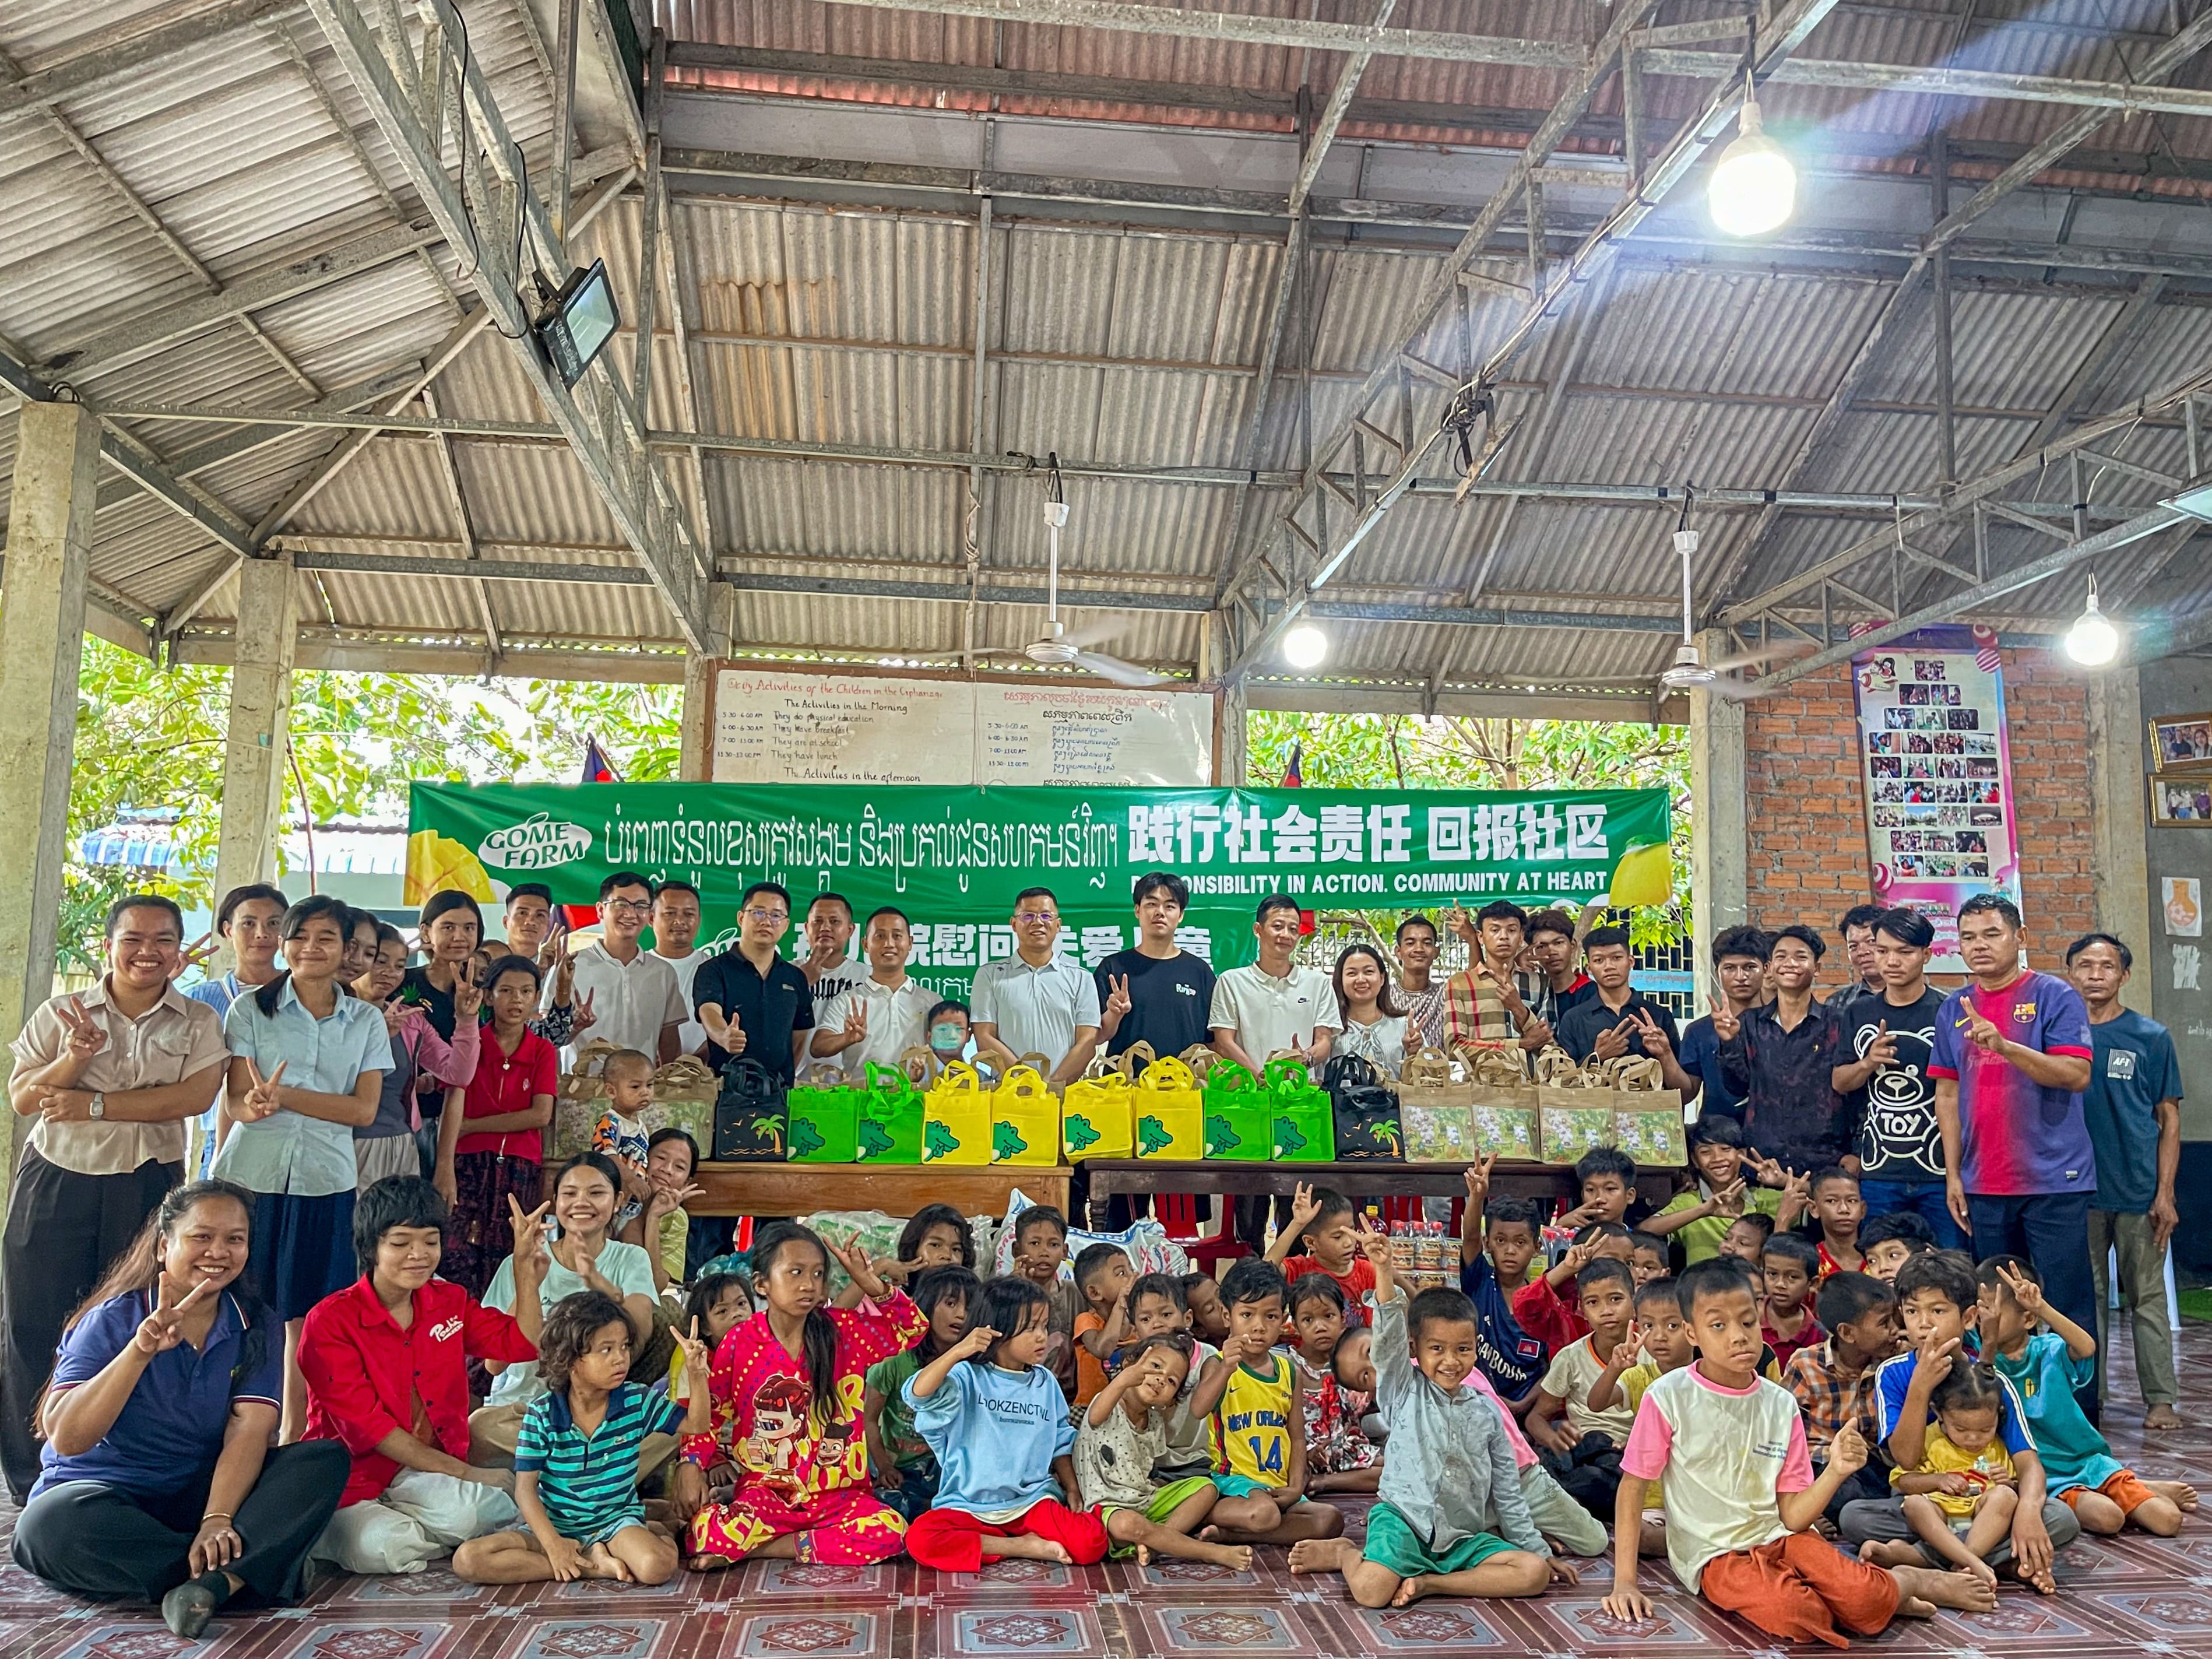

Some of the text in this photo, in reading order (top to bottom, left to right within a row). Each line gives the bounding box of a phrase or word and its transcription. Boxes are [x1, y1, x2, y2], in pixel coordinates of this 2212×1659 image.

[755, 680, 803, 692] Activities
[806, 686, 816, 697] of
[820, 683, 833, 694] the
[836, 683, 871, 695] Children
[885, 686, 896, 695] the
[773, 711, 790, 723] They
[784, 699, 800, 707] The
[802, 700, 840, 709] Activities
[854, 701, 867, 710] the
[871, 701, 908, 715] Morning
[773, 723, 792, 736] They
[815, 722, 849, 737] breakfast
[772, 736, 792, 749] They
[809, 739, 818, 747] at
[820, 737, 842, 747] school
[771, 750, 792, 762] They
[795, 750, 814, 760] have
[817, 751, 838, 760] lunch
[803, 765, 847, 779] Activities
[864, 772, 878, 781] the
[881, 771, 921, 785] afternoon
[486, 823, 570, 849] GOME
[1128, 804, 1609, 864] 践行社会责任 回报社区
[505, 841, 583, 868] FARM
[1131, 871, 1607, 894] ONSIBILITY IN ACTION. COMMUNITY AT HEART
[1880, 1112, 1922, 1136] TOY
[1228, 1411, 1252, 1433] NEW
[1248, 1435, 1283, 1474] 14
